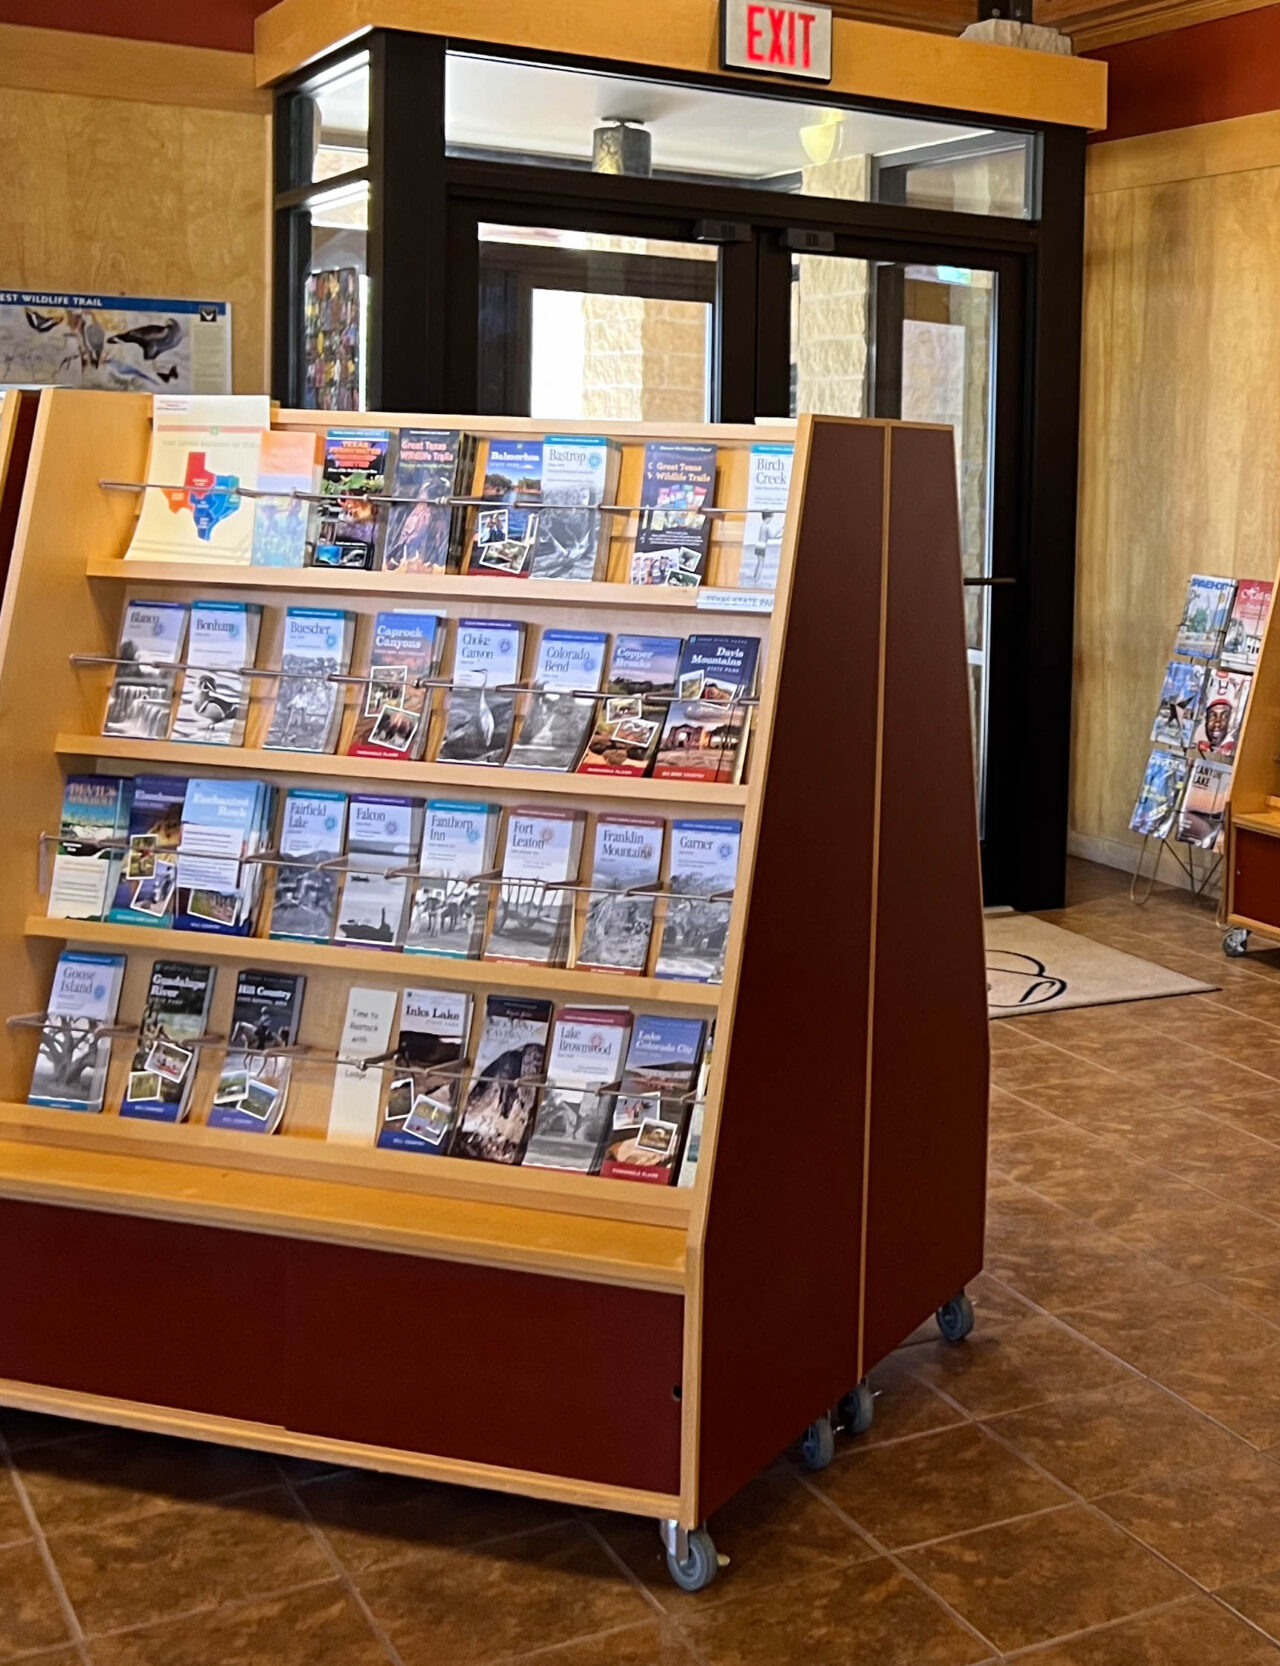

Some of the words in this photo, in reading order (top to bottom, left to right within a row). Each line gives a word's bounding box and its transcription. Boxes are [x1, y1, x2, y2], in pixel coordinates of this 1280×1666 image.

[746, 4, 816, 69] EXIT
[22, 294, 69, 305] WILDLIFE
[73, 296, 103, 307] TRAIL
[401, 440, 424, 450] Great
[425, 440, 447, 451] Texas
[400, 450, 432, 461] Wildlife
[433, 451, 454, 462] Trails
[490, 451, 540, 462] Balmorhea
[549, 449, 586, 466] Bastrop
[657, 462, 679, 471] Great
[681, 463, 702, 472] Texas
[757, 458, 785, 472] Birch
[656, 472, 687, 481] Wildlife
[688, 472, 711, 483] Trails
[755, 471, 787, 486] Creek
[130, 611, 160, 626] Blanco
[195, 618, 236, 633] Bonham
[290, 621, 331, 636] Buescher
[376, 625, 423, 639] Caprock
[375, 636, 422, 650] Canyons
[463, 632, 491, 647] Choke
[461, 647, 494, 663] Canyon
[546, 646, 591, 662] Colorado
[616, 646, 654, 660] Copper
[716, 646, 745, 658] Davis
[544, 659, 570, 673] Bend
[690, 654, 743, 667] Mountains
[218, 805, 247, 817] Rock
[290, 801, 327, 817] Fairfield
[356, 806, 386, 822] Falcon
[288, 815, 309, 829] Lake
[431, 814, 473, 832] Fanthorp
[513, 820, 534, 834] Fort
[430, 828, 446, 842] Inn
[602, 829, 644, 844] Franklin
[512, 835, 546, 850] Leaton
[680, 835, 715, 850] Garner
[601, 843, 653, 860] Mountains
[63, 966, 97, 980] Goose
[60, 979, 93, 995] Island
[152, 973, 207, 990] Guadalupe
[150, 984, 180, 998] River
[238, 984, 256, 995] Hill
[256, 986, 293, 1000] Country
[352, 1008, 369, 1018] Time
[406, 1005, 430, 1018] Inks
[432, 1008, 460, 1020] Lake
[560, 1026, 582, 1039] Lake
[638, 1030, 661, 1041] Lake
[558, 1041, 613, 1056] Brownwood
[635, 1041, 676, 1052] Colorado
[677, 1043, 693, 1056] City
